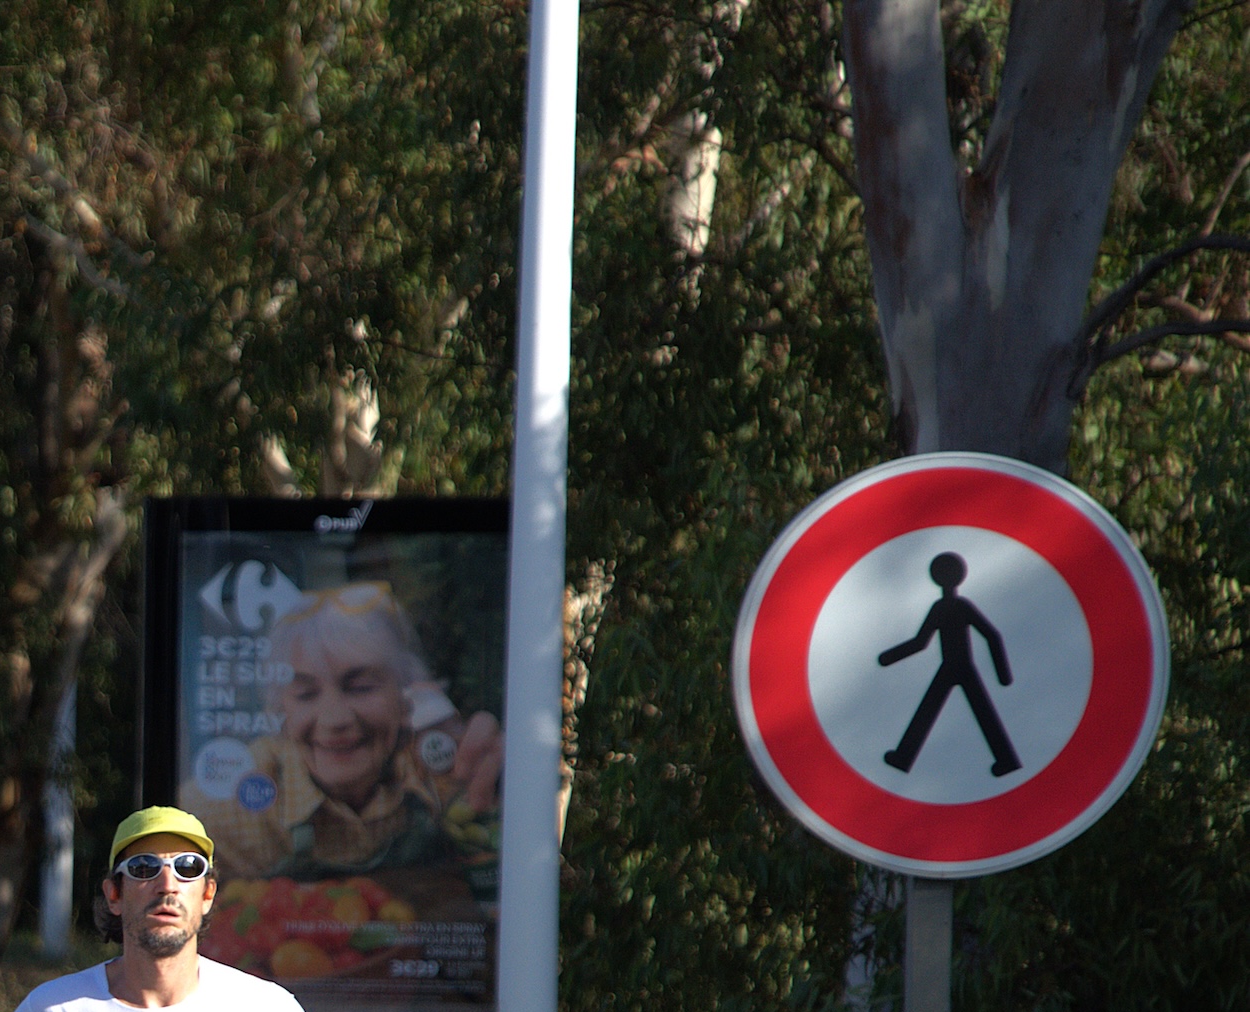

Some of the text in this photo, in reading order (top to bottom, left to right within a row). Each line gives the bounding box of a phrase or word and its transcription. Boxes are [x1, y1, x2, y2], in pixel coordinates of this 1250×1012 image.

[198, 660, 295, 685] LE SUD
[199, 685, 236, 709] EN
[198, 711, 287, 735] SPRAY
